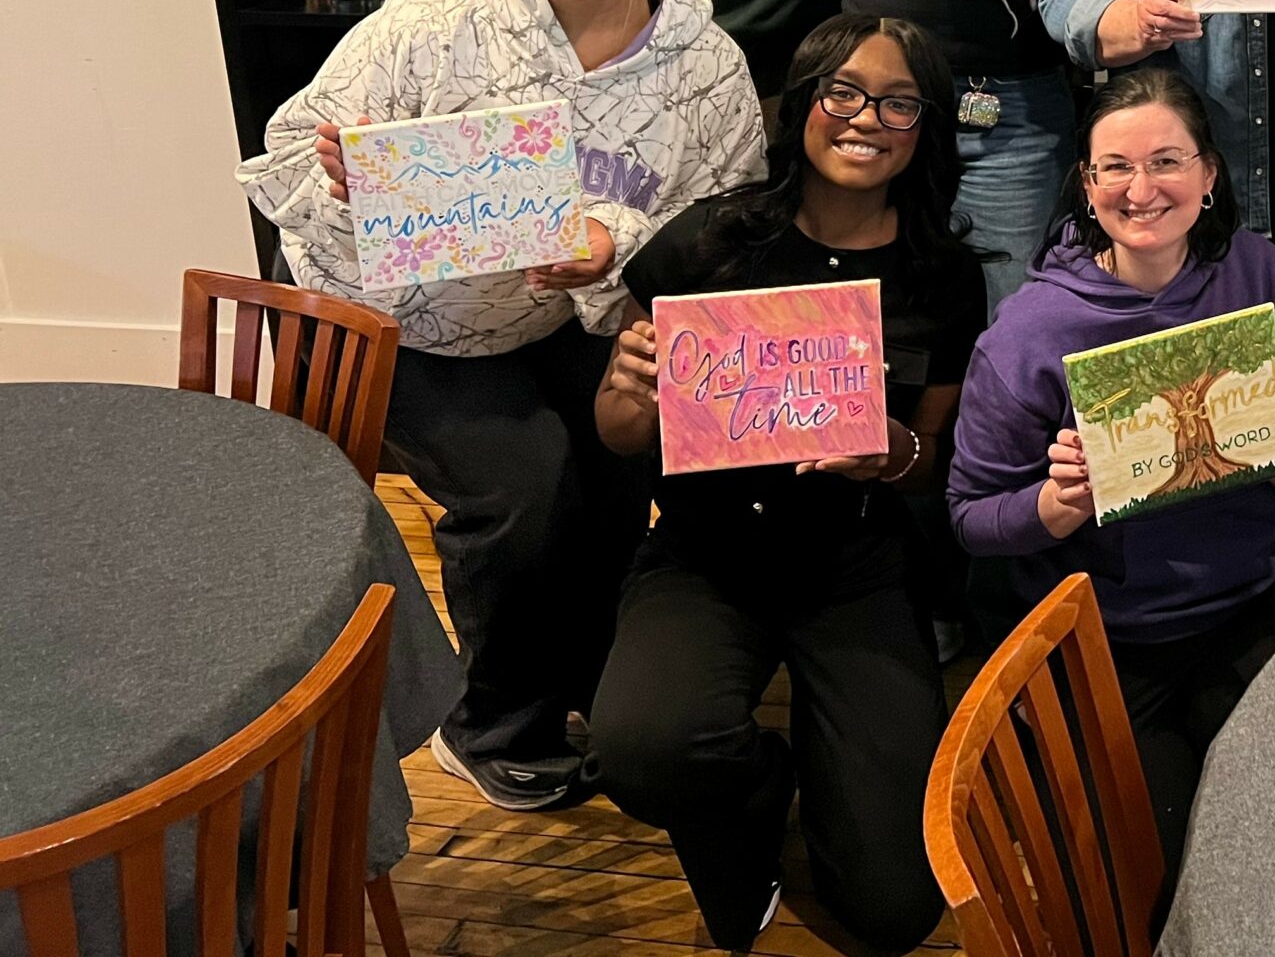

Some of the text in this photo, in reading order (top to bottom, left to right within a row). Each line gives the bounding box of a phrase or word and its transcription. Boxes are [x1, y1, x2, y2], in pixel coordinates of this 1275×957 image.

[499, 172, 569, 195] MOVE
[362, 192, 571, 238] mountains
[669, 330, 848, 403] God IS GOOD
[783, 365, 871, 399] ALL THE
[713, 373, 838, 441] time
[1131, 426, 1271, 479] BY GOD'S WORD
